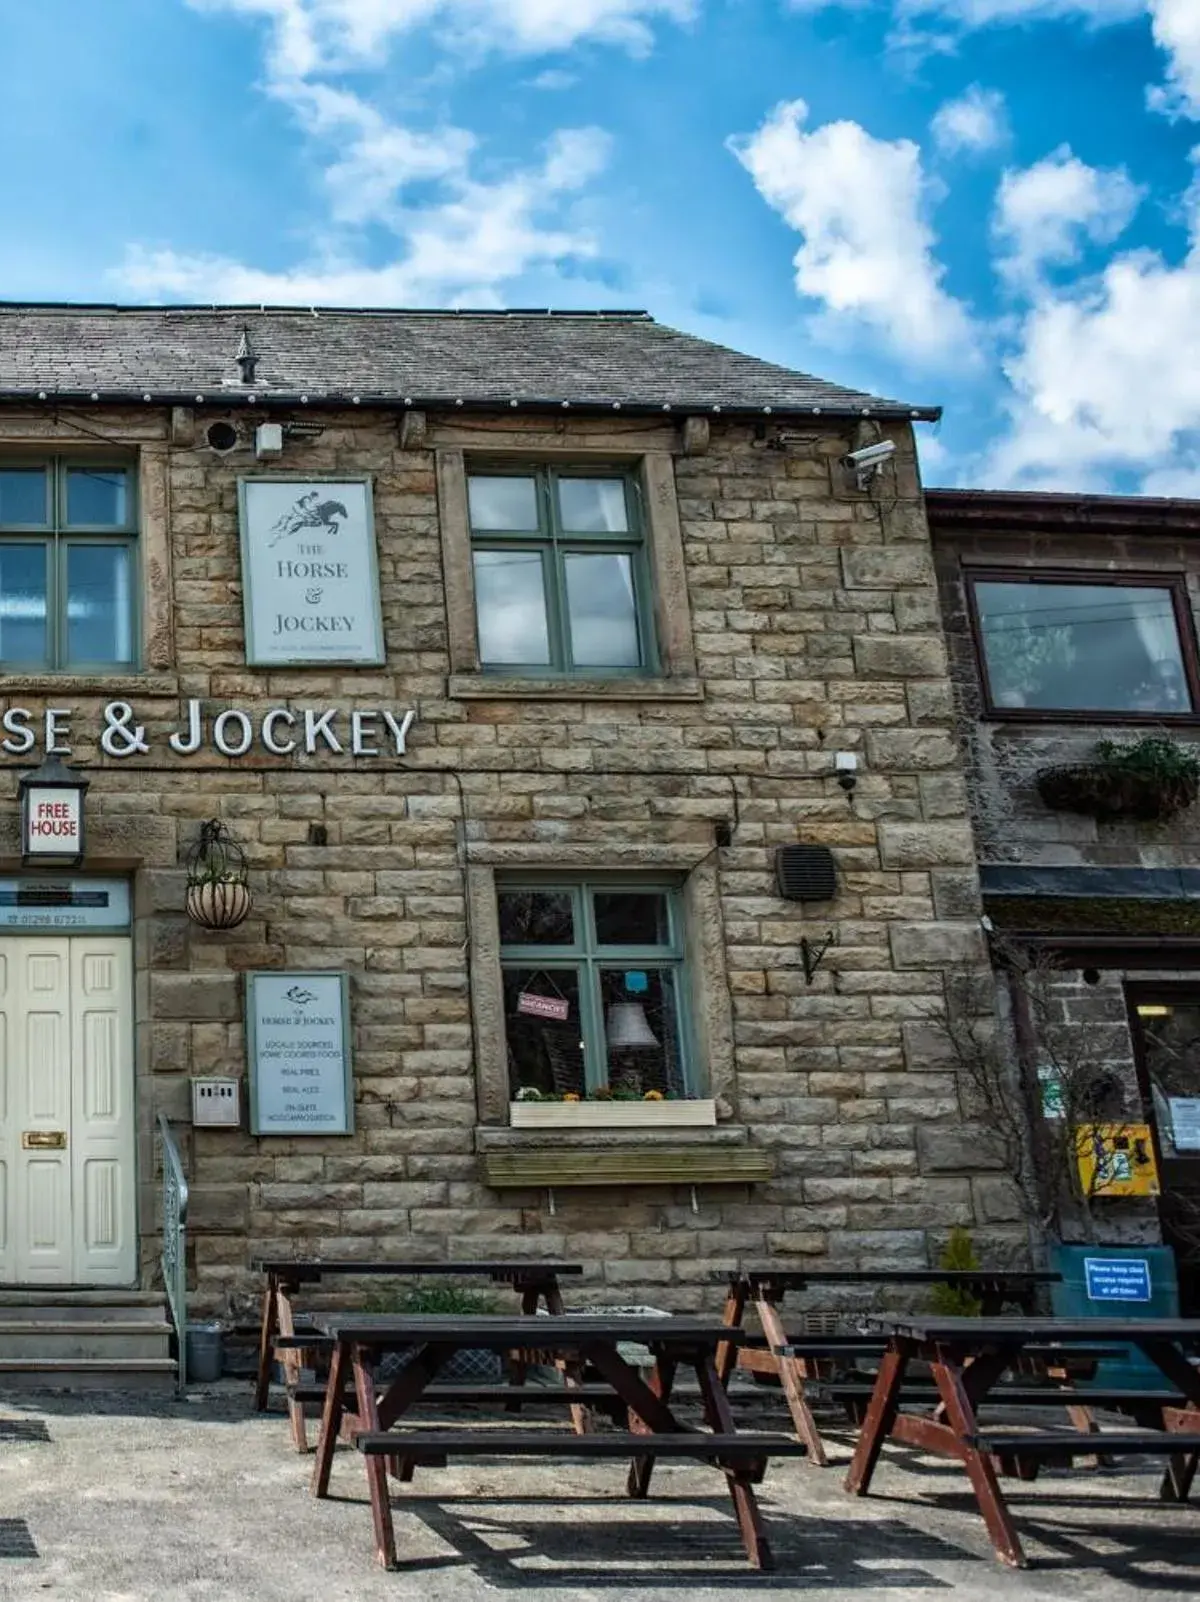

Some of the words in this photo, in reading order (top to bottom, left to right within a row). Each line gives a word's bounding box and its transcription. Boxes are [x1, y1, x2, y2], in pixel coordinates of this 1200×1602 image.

[297, 544, 323, 555] THE
[277, 561, 348, 578] HORSE
[304, 587, 323, 605] &
[273, 614, 355, 635] JOCKEY
[100, 701, 150, 757] &
[169, 699, 417, 757] JOCKEY
[38, 803, 69, 818] FREE
[31, 820, 77, 836] HOUSE
